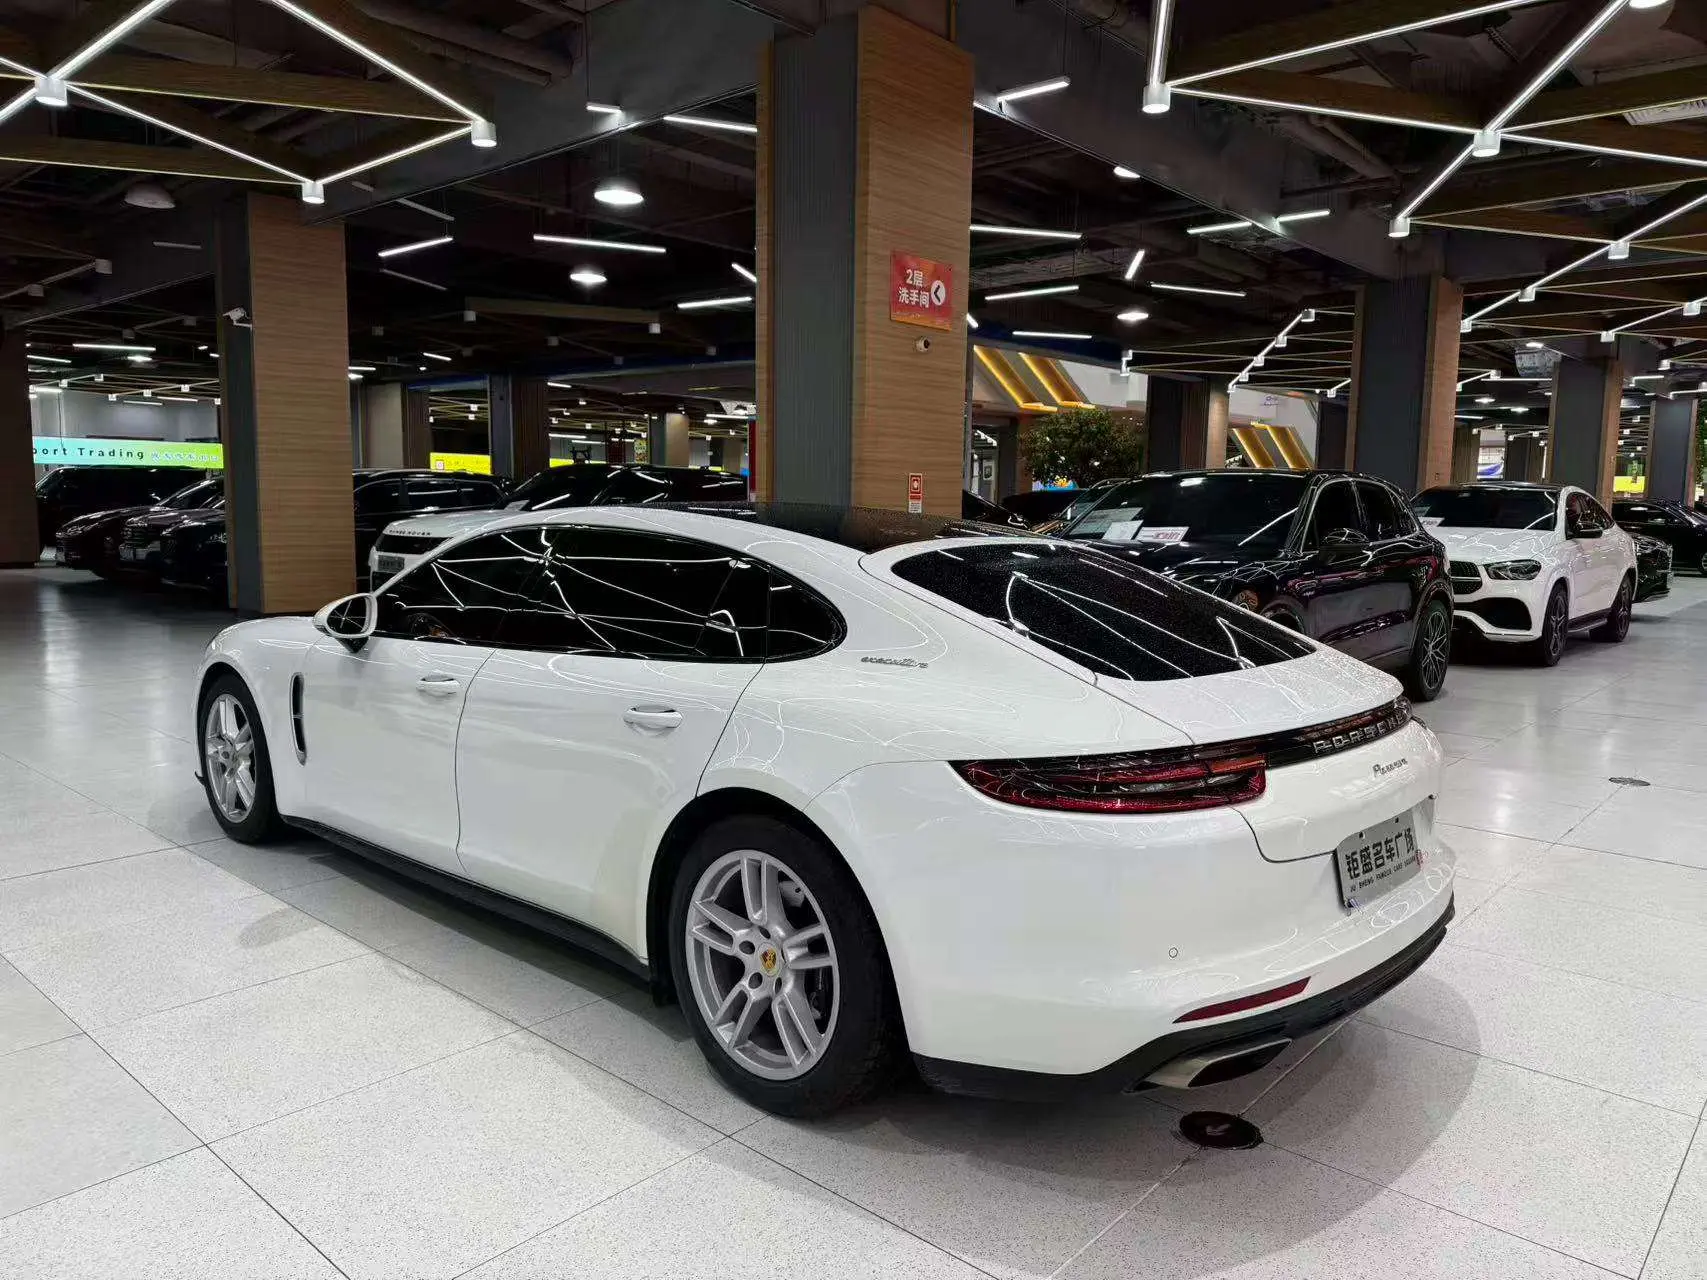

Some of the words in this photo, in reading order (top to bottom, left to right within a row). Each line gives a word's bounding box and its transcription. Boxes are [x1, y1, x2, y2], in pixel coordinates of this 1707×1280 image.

[906, 269, 923, 288] 2层
[898, 287, 930, 309] 洗手间
[77, 447, 144, 460] Trading
